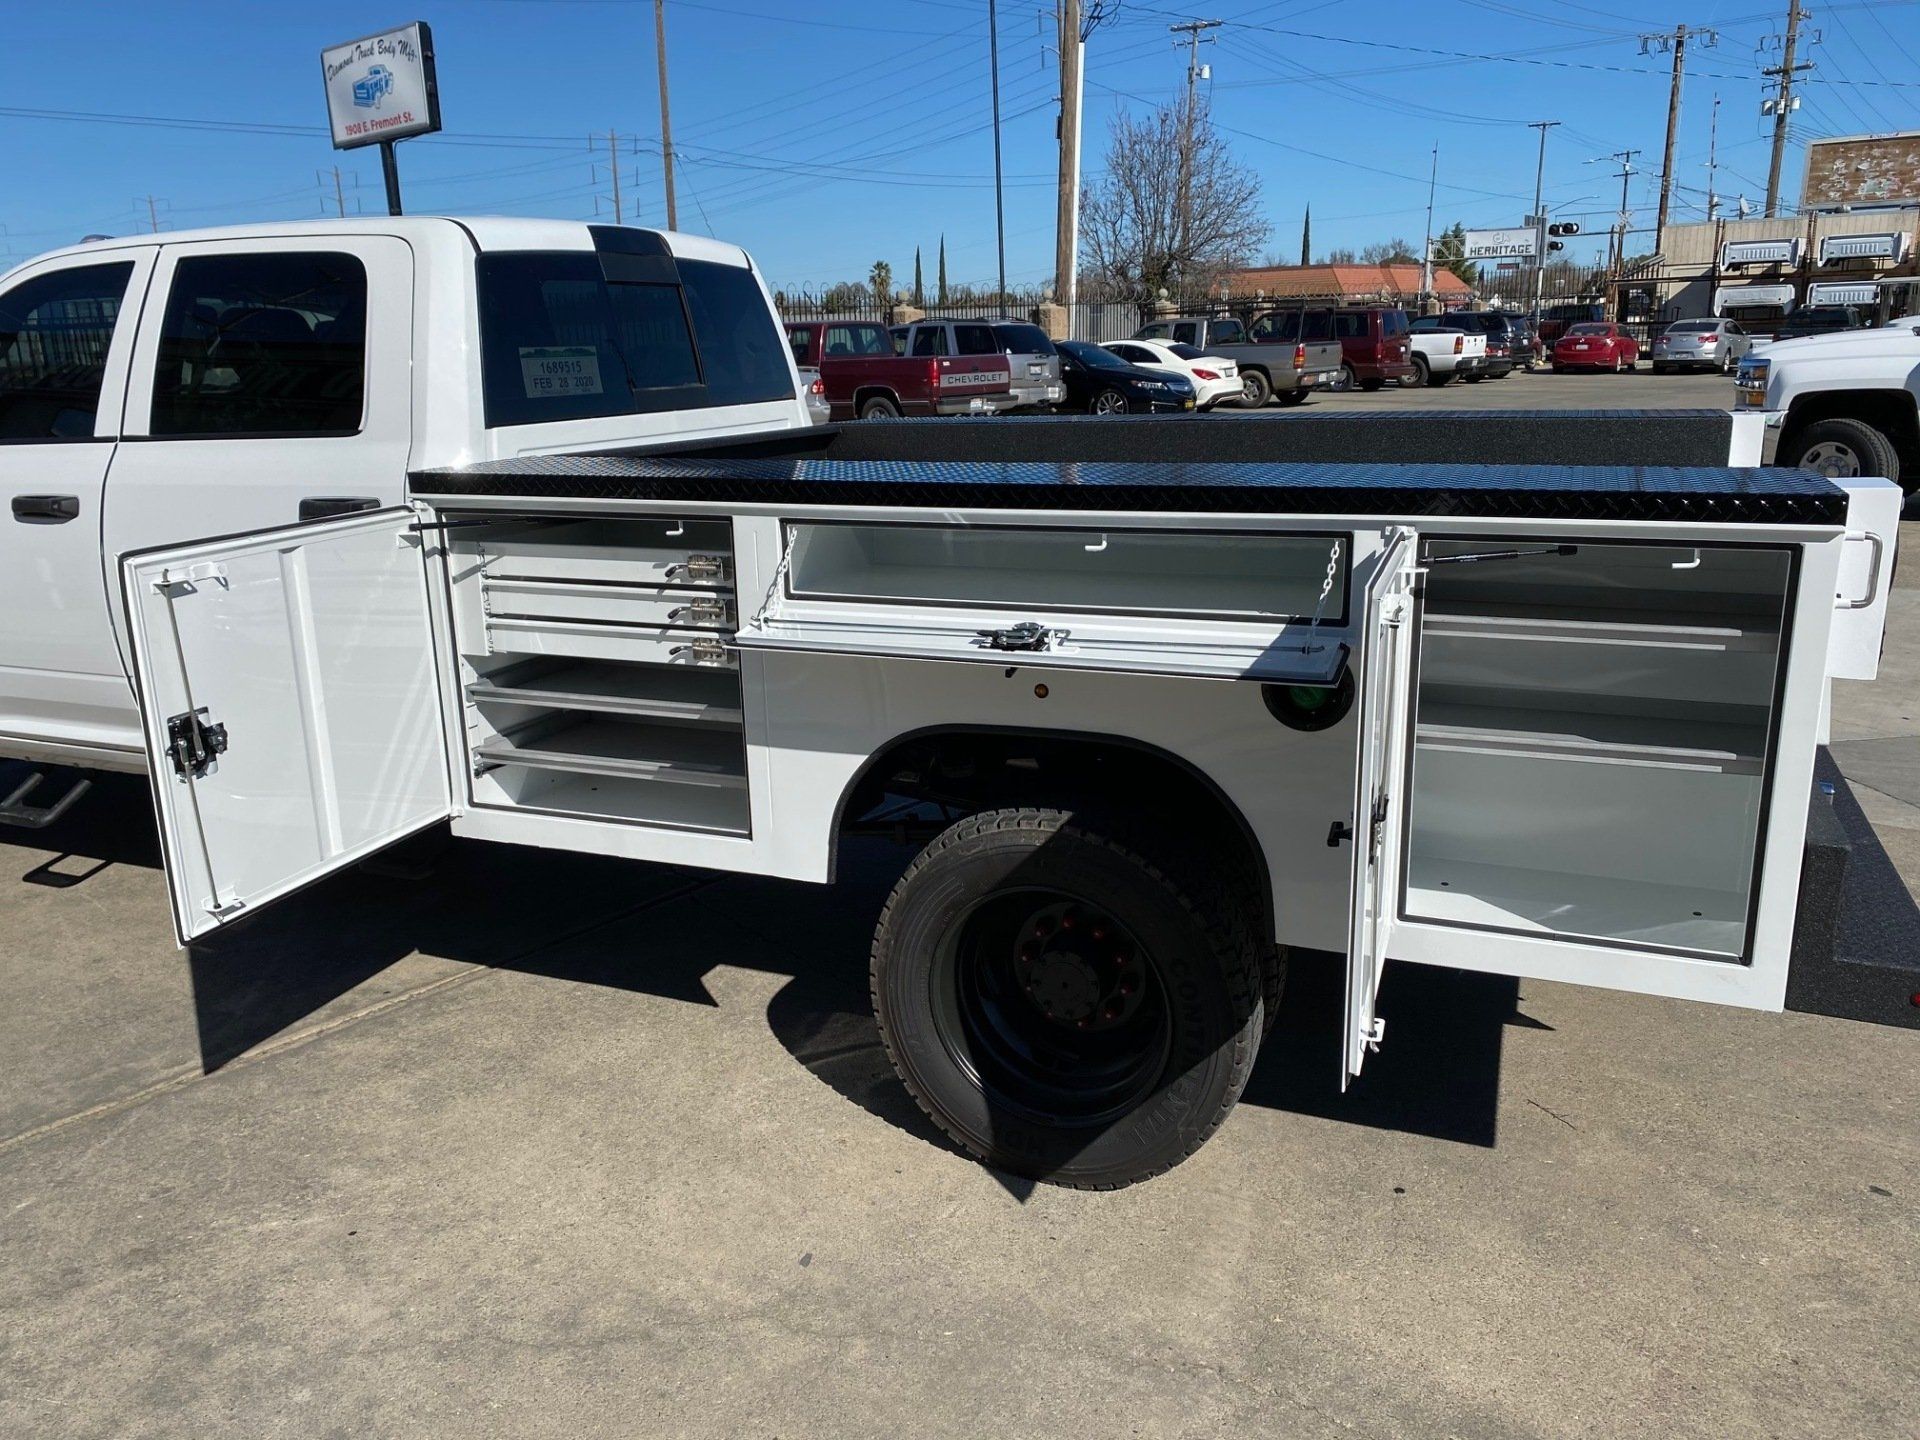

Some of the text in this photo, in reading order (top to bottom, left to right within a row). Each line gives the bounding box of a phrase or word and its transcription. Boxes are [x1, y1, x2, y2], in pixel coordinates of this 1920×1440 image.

[355, 43, 375, 60] Truck
[377, 39, 396, 59] Body
[345, 111, 415, 136] 1908 E. Fremont St.
[1470, 244, 1532, 256] HERMITAGE
[540, 360, 582, 374] 1689515
[533, 377, 553, 389] FEB
[574, 375, 594, 388] 2020
[947, 373, 1003, 385] CHEVROLET
